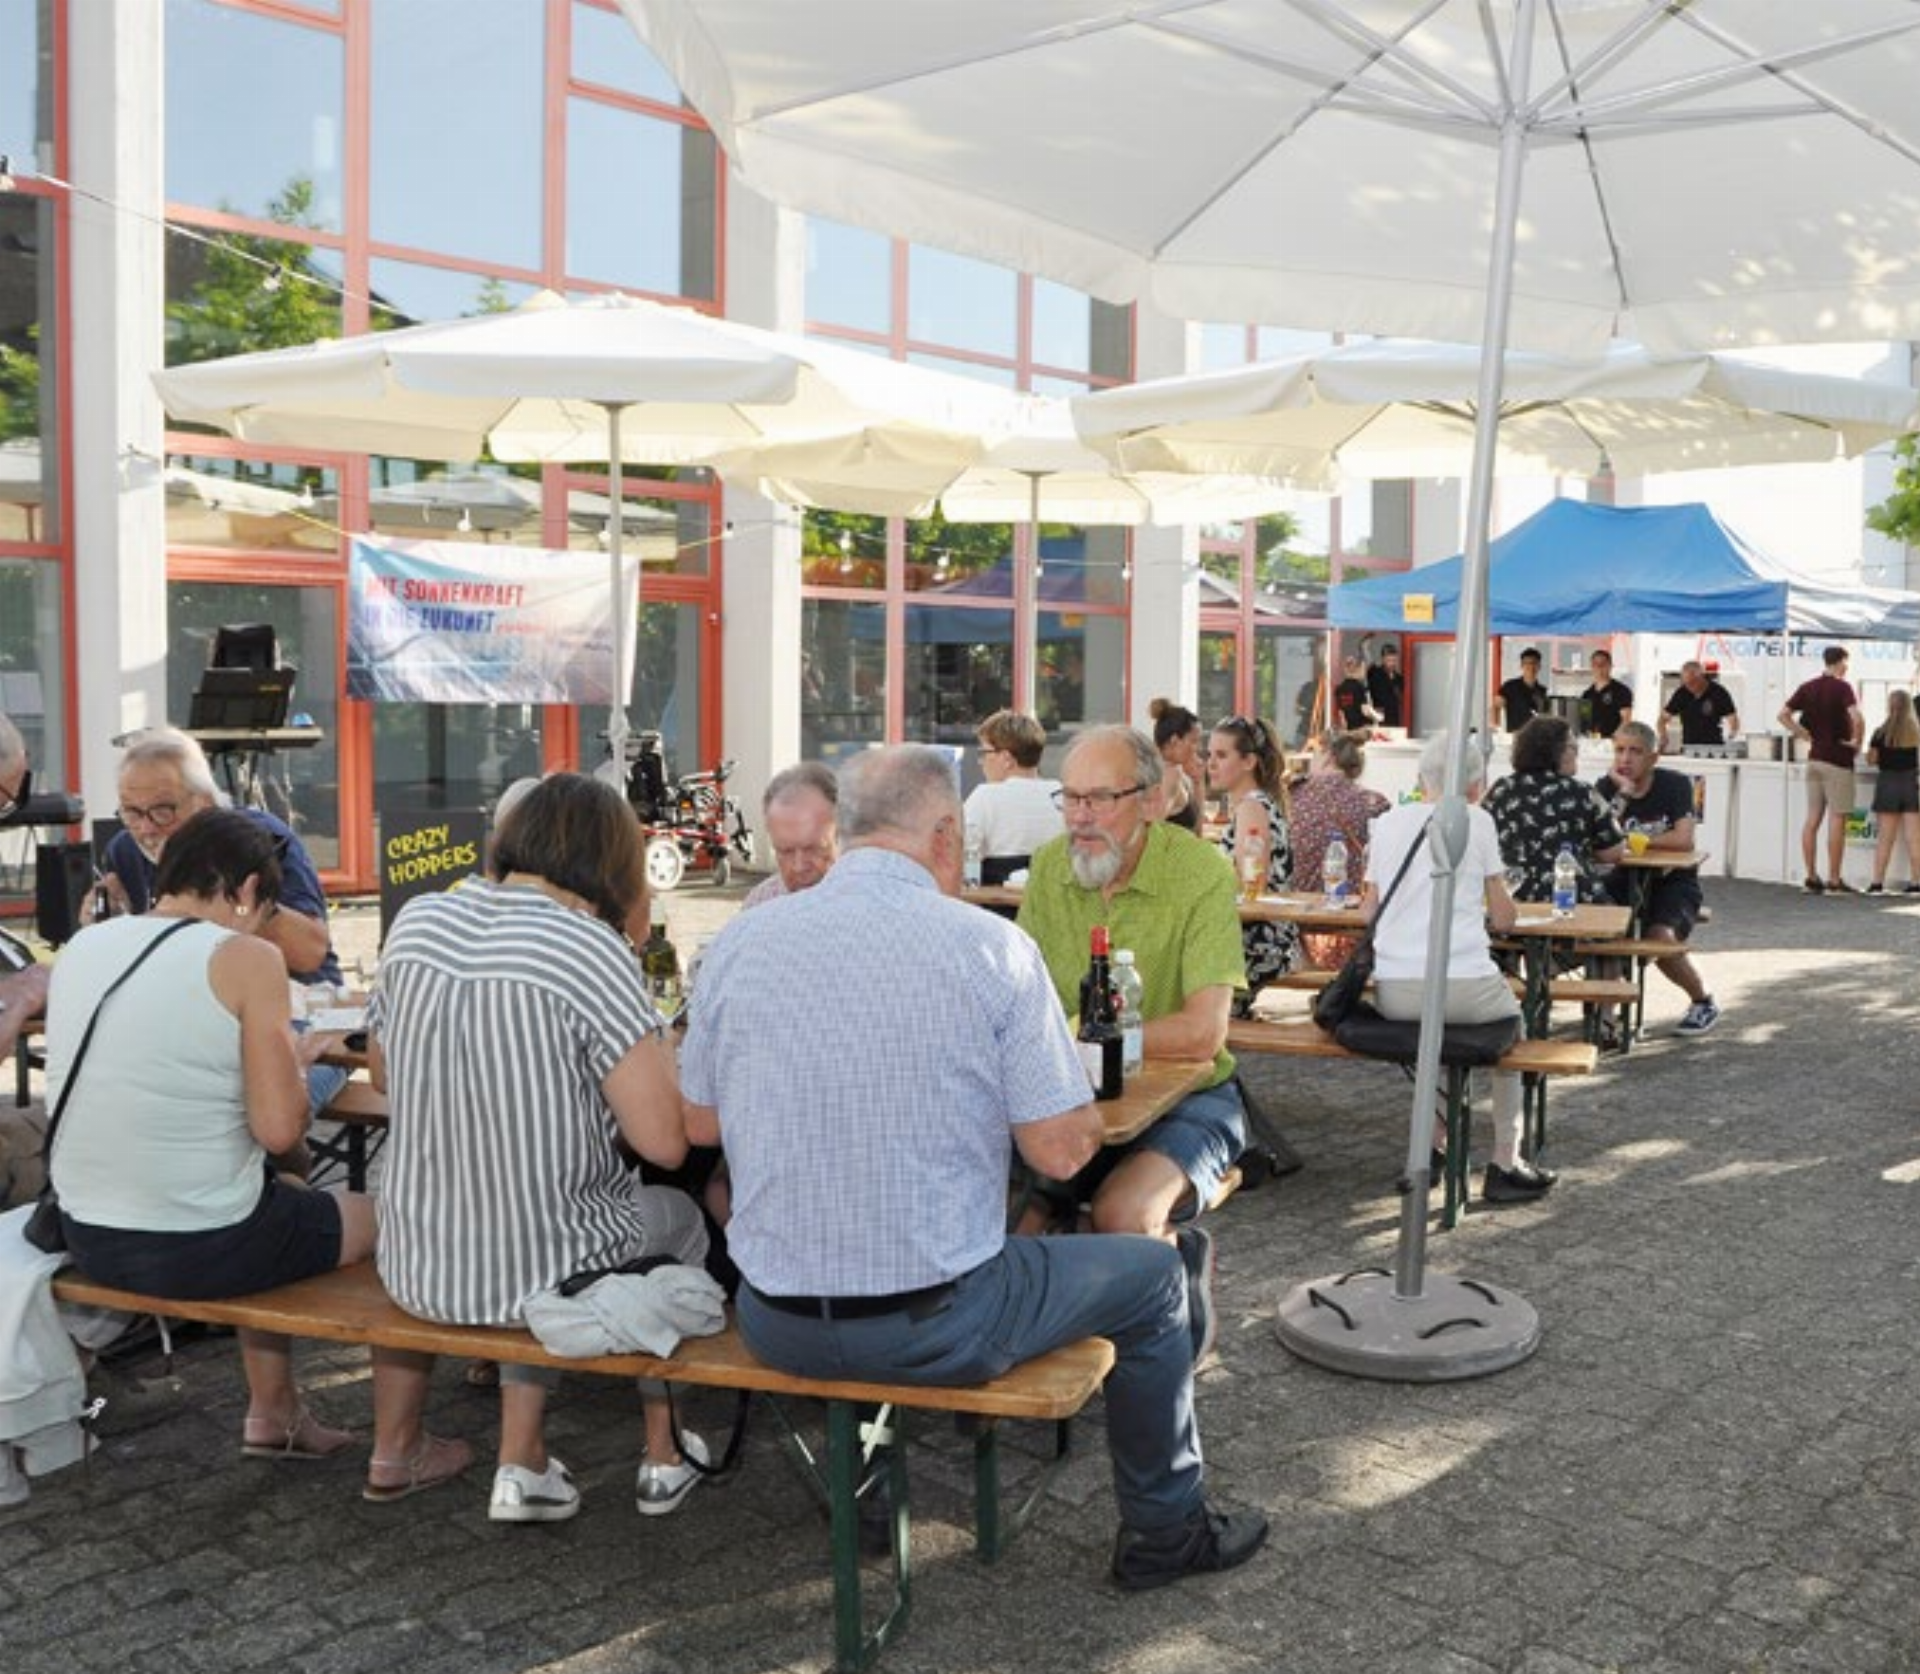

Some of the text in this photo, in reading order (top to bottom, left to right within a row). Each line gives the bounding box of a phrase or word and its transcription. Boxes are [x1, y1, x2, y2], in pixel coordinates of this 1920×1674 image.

[404, 578, 524, 606] SONNENKRAFT
[387, 824, 449, 859] CRAZY
[388, 841, 477, 885] HOPPERS
